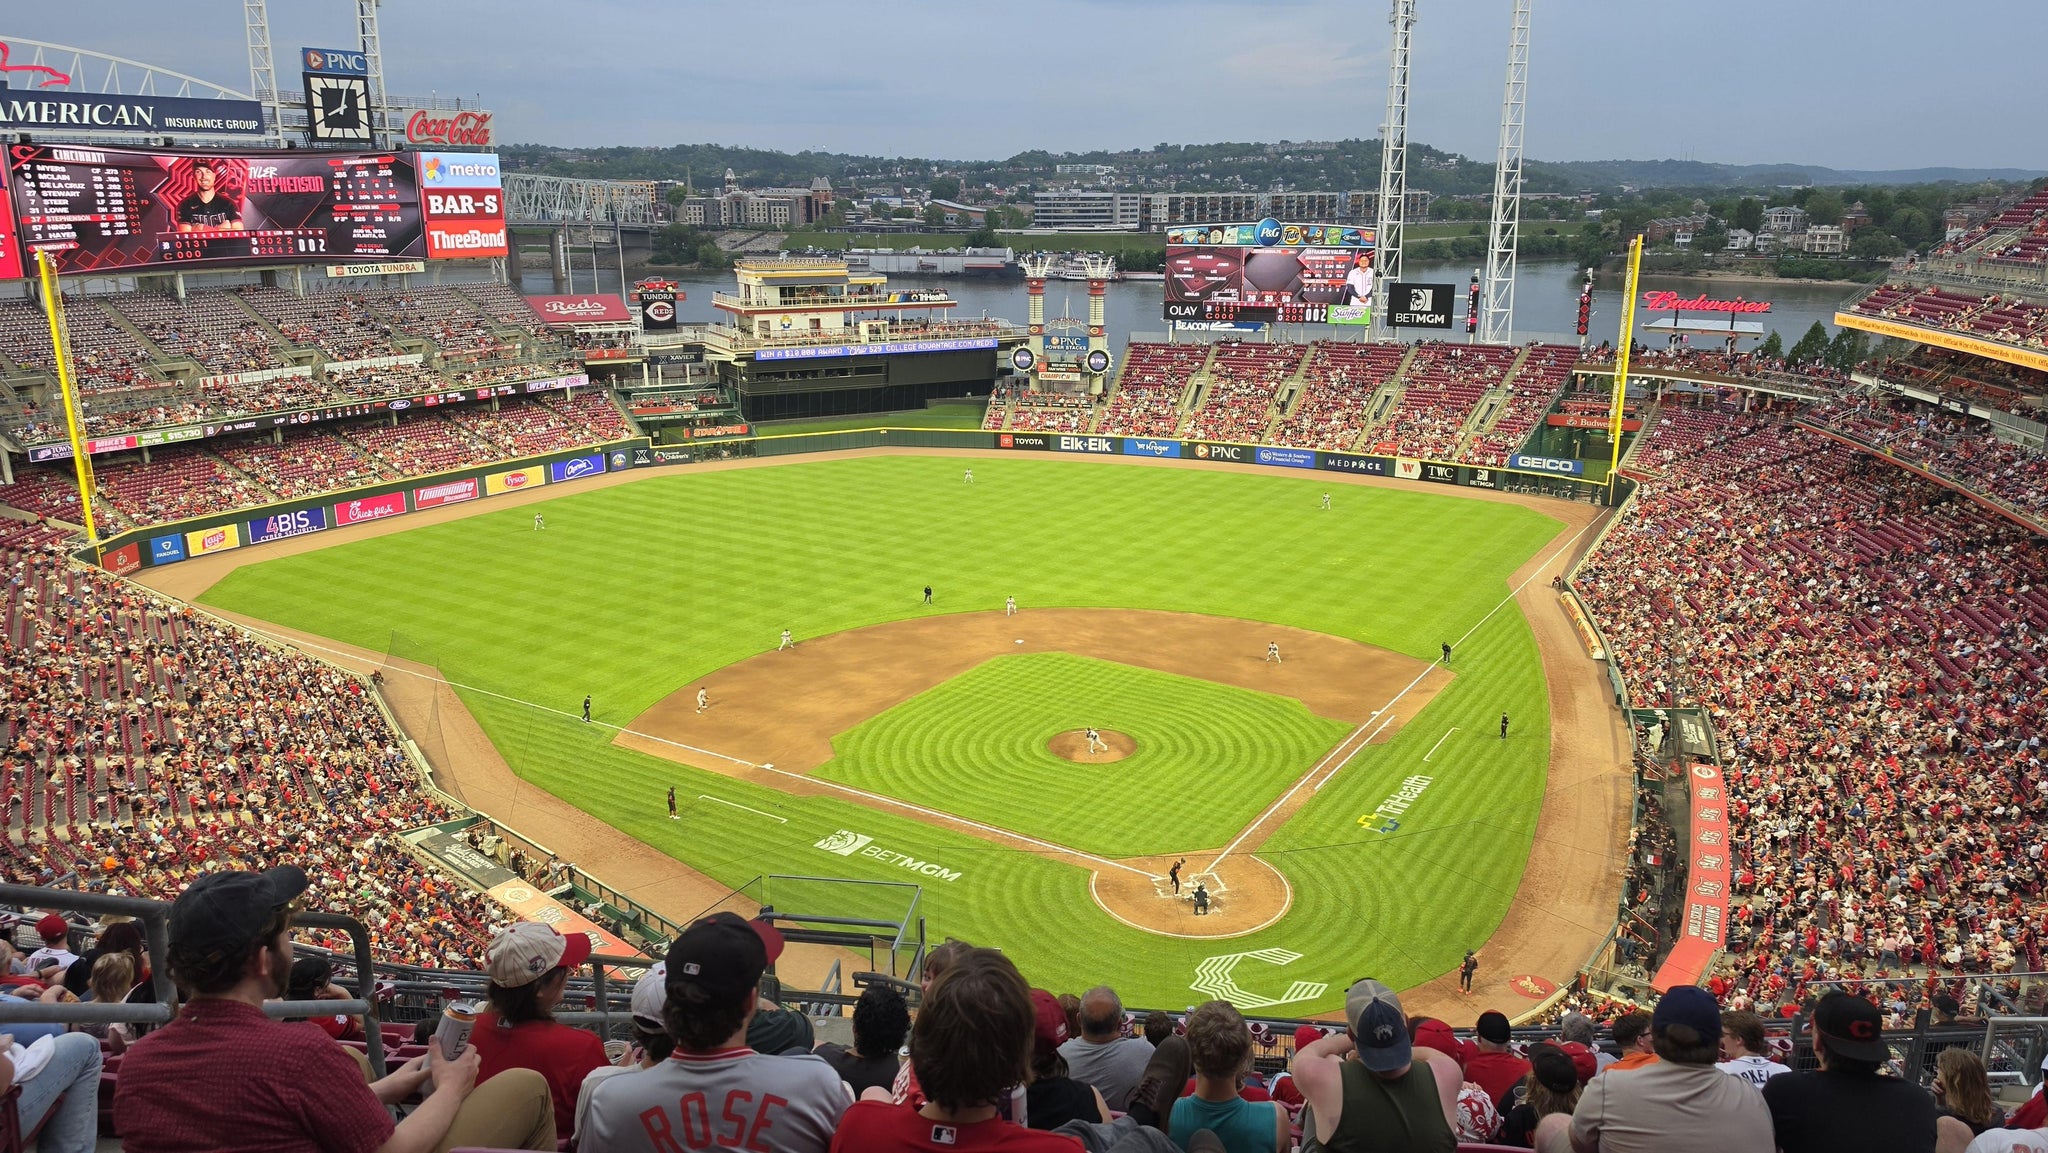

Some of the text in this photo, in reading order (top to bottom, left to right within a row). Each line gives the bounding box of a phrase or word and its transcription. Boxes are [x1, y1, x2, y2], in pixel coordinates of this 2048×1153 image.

[325, 53, 364, 70] PNC
[165, 117, 224, 130] INSURANCE
[226, 119, 258, 130] GROUP
[53, 150, 106, 163] CINCINNATI
[36, 164, 66, 172] MYERS
[248, 166, 278, 178] TYLER
[450, 163, 496, 176] metro
[248, 176, 324, 193] STEPHENSON
[428, 195, 498, 214] BAR-S
[430, 230, 506, 249] ThreeBond
[1260, 228, 1280, 238] P&G
[1284, 231, 1300, 240] Tide
[348, 264, 416, 274] TOYOTA TUNDRA
[918, 292, 948, 302] TriHealth
[1644, 290, 1770, 312] Budweiser
[546, 299, 607, 316] Reds
[1170, 306, 1198, 316] OLAY
[1332, 308, 1364, 319] Swiffer
[1396, 312, 1445, 324] BETMGM
[1176, 320, 1210, 331] BEACON
[818, 348, 843, 356] AWARD
[870, 346, 882, 354] 529
[168, 429, 200, 440] $15,730
[1060, 437, 1112, 452] Elk+Elk
[1146, 442, 1169, 455] Kroger
[1212, 447, 1240, 460] PNC
[1518, 456, 1574, 471] GEICO
[1428, 465, 1453, 478] TWC
[506, 474, 528, 485] Tyson
[1470, 480, 1494, 488] BETMGM
[266, 510, 309, 533] 4BIS
[260, 526, 318, 542] CYBER SECURITY
[156, 550, 179, 558] FANDUEL
[1376, 775, 1433, 815] TriHealth
[860, 846, 962, 881] BETMGM
[1688, 920, 1701, 936] WORLD
[1703, 905, 1720, 942] CHAMPIONS
[639, 1088, 789, 1153] ROSE
